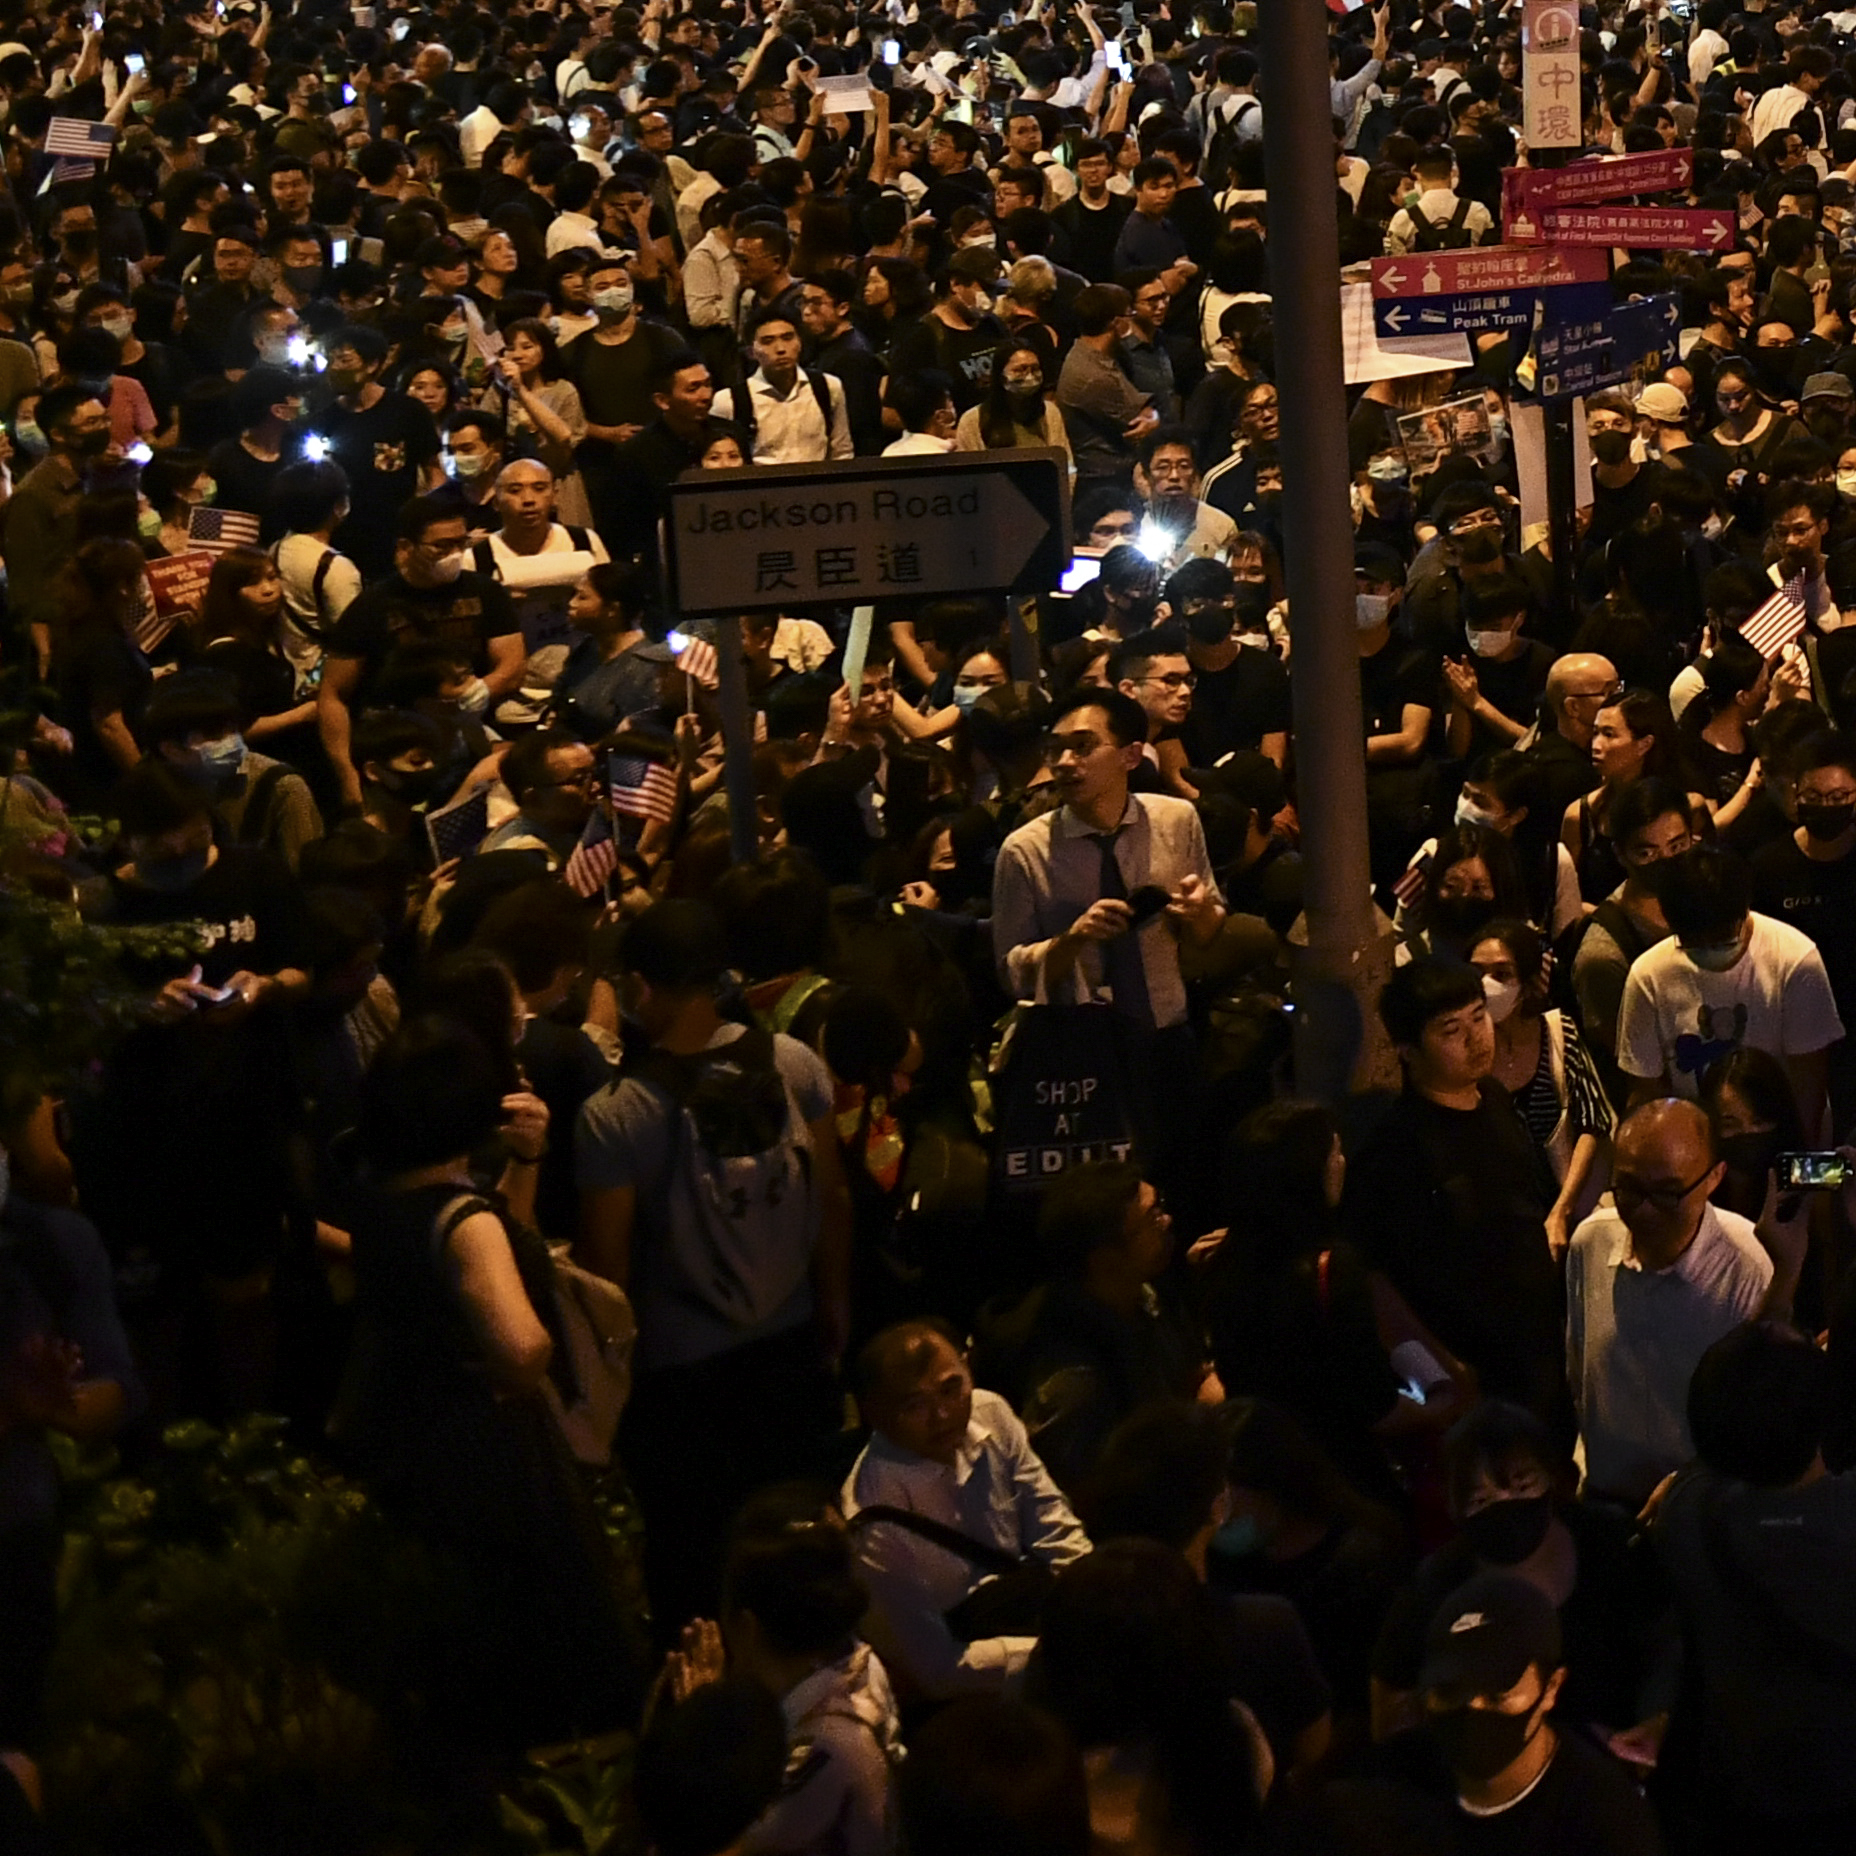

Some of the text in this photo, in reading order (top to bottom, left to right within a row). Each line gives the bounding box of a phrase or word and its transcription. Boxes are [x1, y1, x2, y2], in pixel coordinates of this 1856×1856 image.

[1538, 63, 1576, 141] 中環
[1453, 311, 1529, 330] Peak Tram
[686, 487, 980, 534] Jackson Road
[755, 542, 923, 593] 昃臣道
[1034, 1077, 1099, 1105] SHOP
[1054, 1112, 1081, 1136] AT
[1006, 1142, 1132, 1176] EDIT
